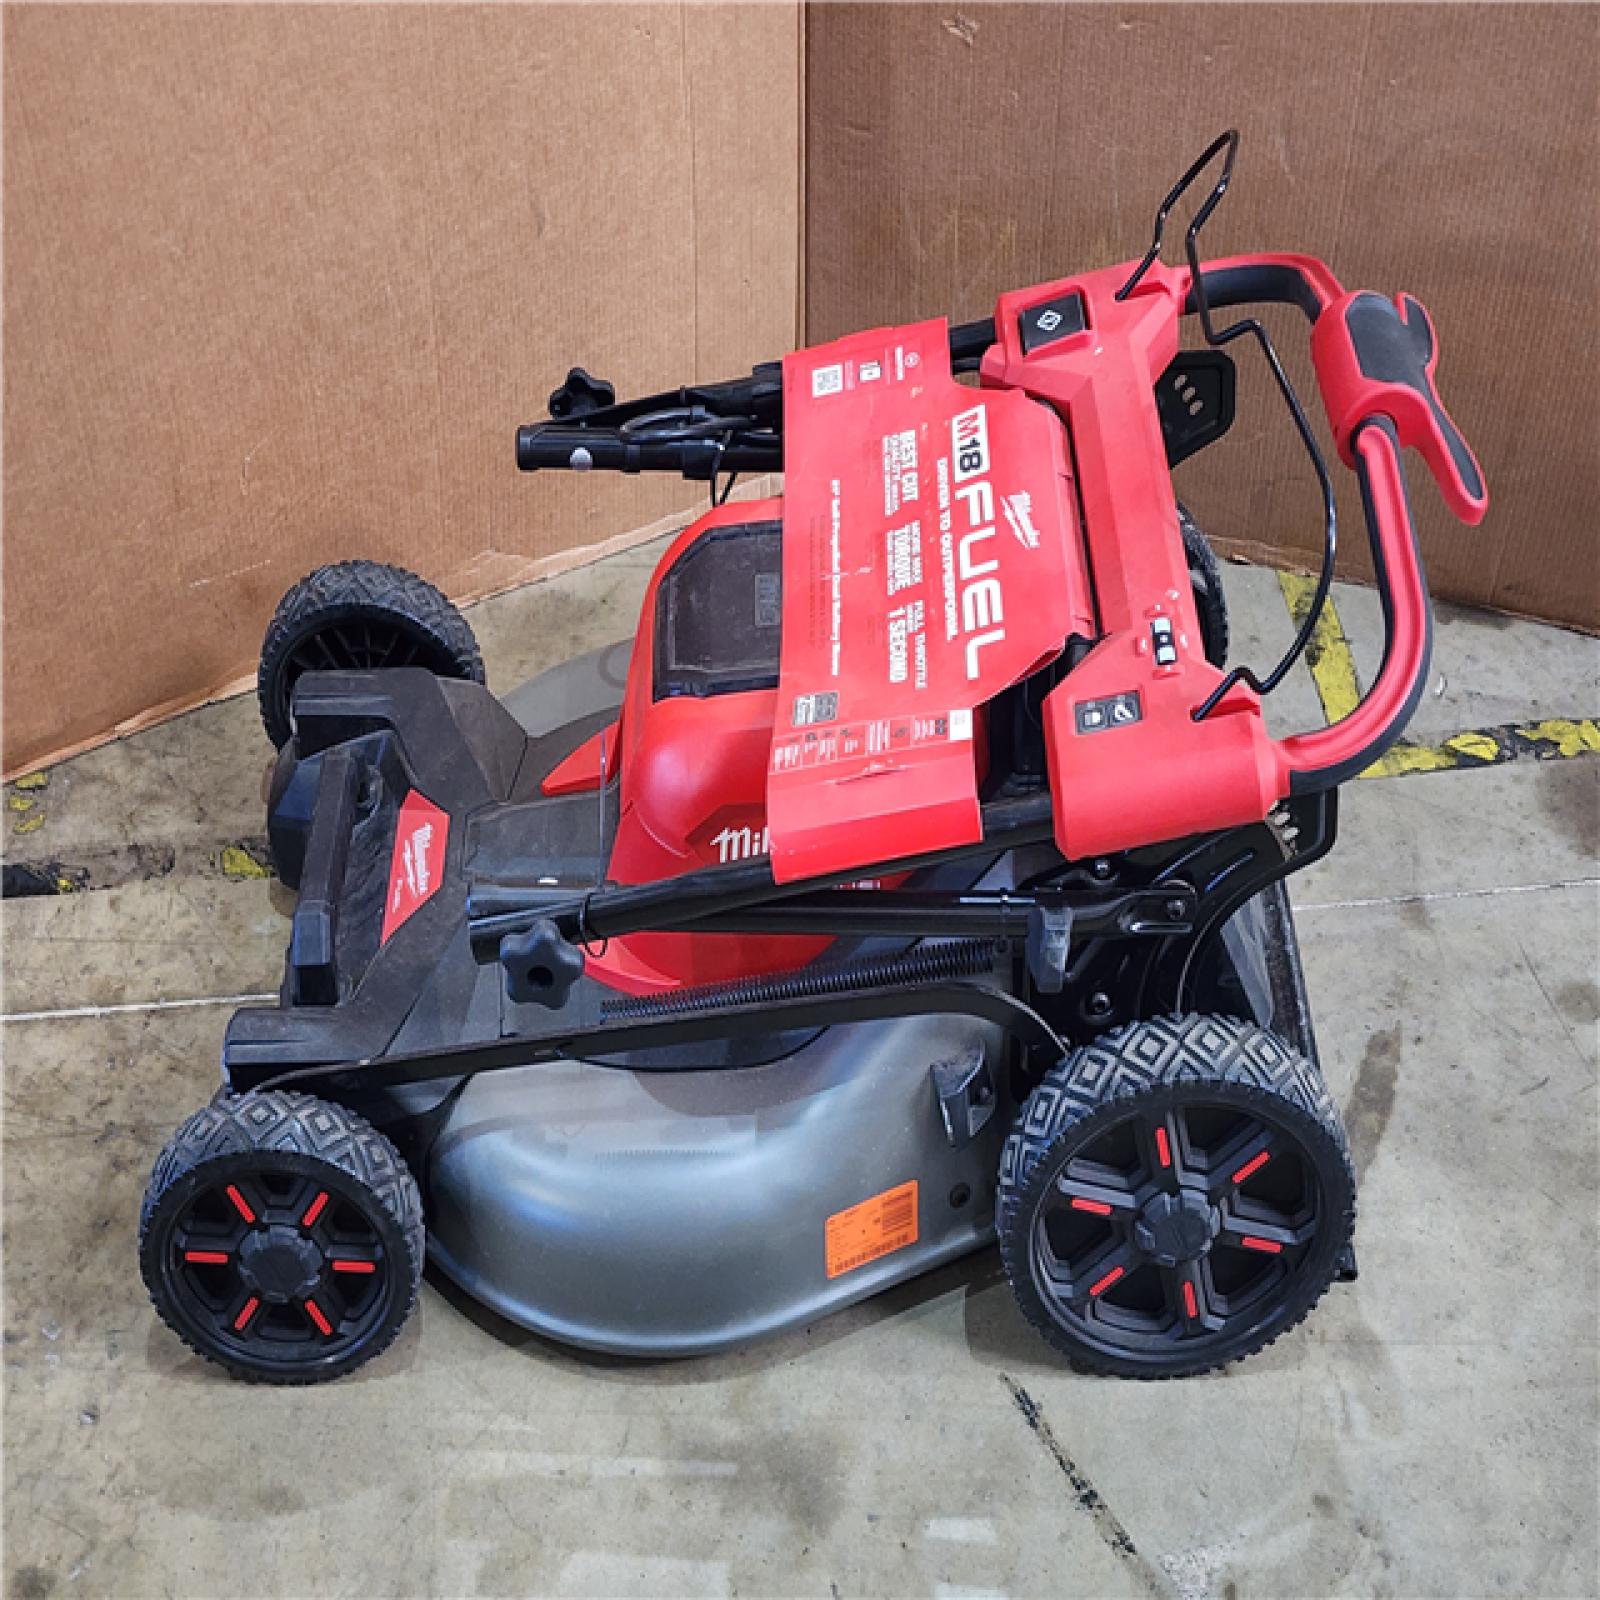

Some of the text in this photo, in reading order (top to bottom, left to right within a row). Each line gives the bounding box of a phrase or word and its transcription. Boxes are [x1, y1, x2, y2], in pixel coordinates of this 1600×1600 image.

[899, 429, 919, 503] BEST CUT
[937, 457, 949, 509] DRIVEN
[939, 509, 951, 532] TO
[954, 411, 1005, 680] M18 FUEL
[893, 525, 911, 590] TORQUE
[889, 607, 906, 619] 1
[913, 600, 928, 689] FULL THROTTLE
[889, 619, 907, 683] SECOND
